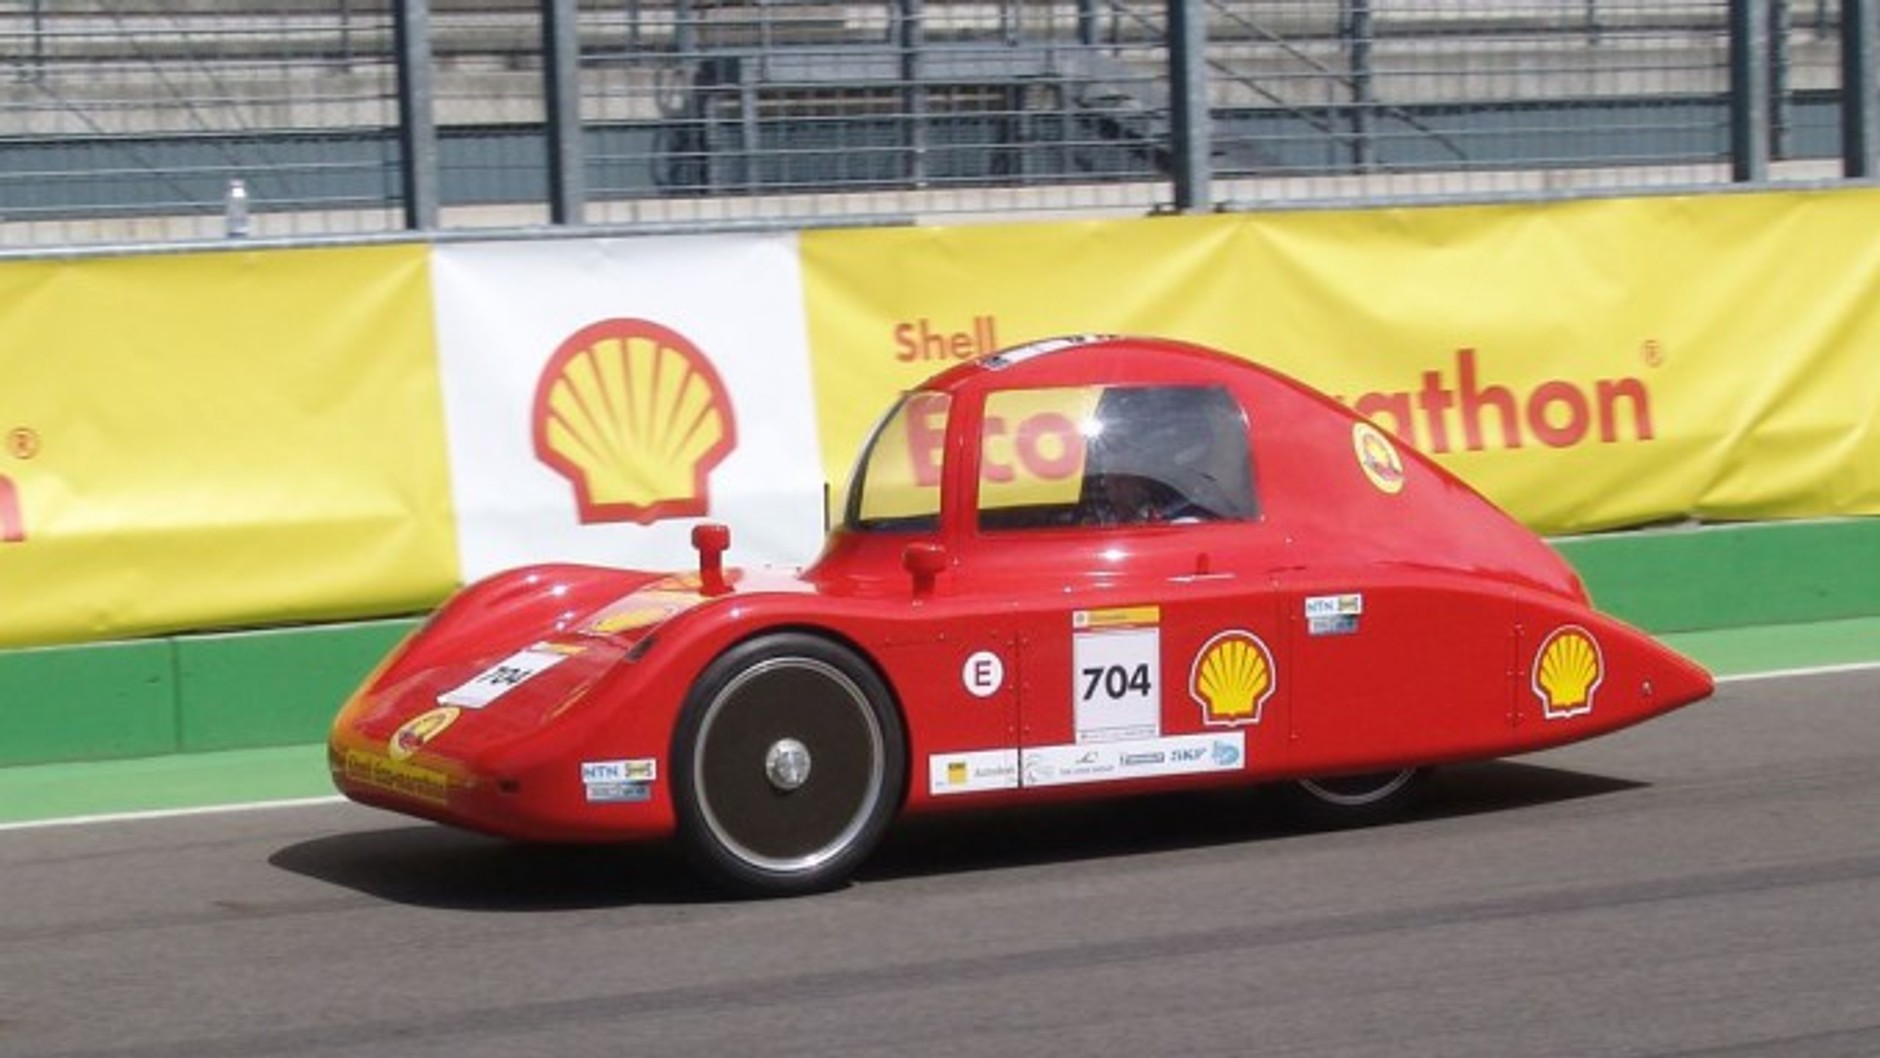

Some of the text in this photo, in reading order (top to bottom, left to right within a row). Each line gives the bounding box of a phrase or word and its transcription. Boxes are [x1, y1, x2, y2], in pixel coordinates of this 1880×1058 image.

[894, 315, 995, 362] Shell
[906, 347, 1656, 488] Eco athon
[974, 660, 992, 686] E
[1082, 664, 1151, 700] 704
[583, 764, 618, 779] NTN
